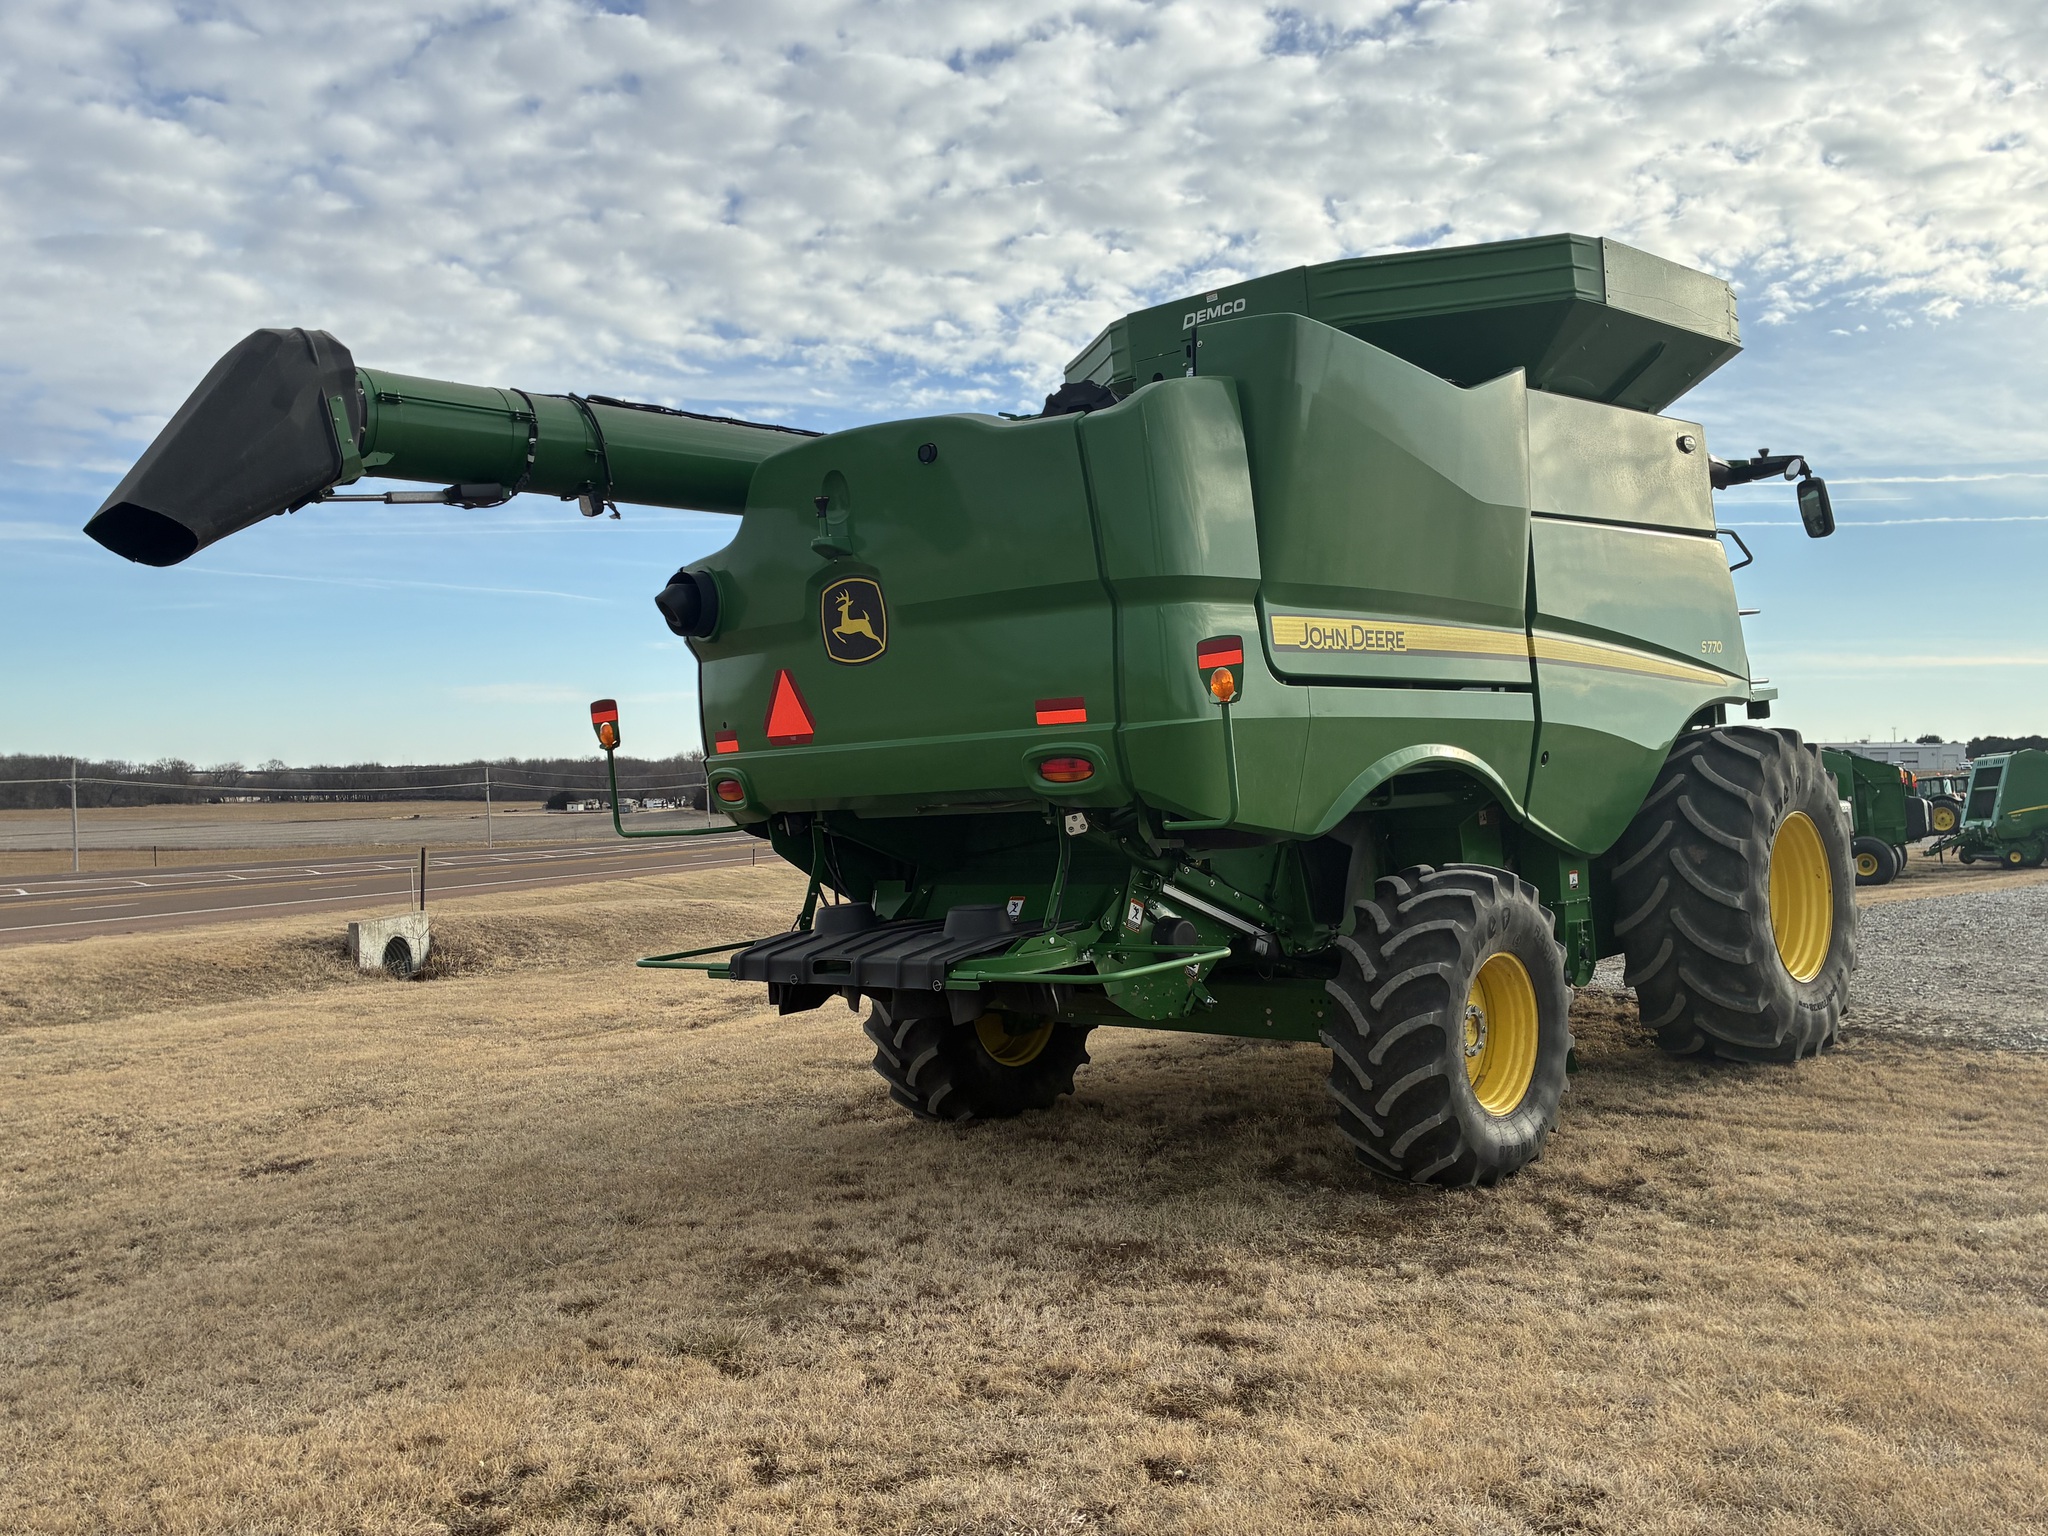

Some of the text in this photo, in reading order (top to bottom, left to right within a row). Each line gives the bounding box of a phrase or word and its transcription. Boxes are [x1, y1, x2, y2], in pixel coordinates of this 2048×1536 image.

[1182, 298, 1246, 331] DEMCO
[1299, 622, 1406, 650] JOHN DEERE
[1701, 640, 1723, 654] S770
